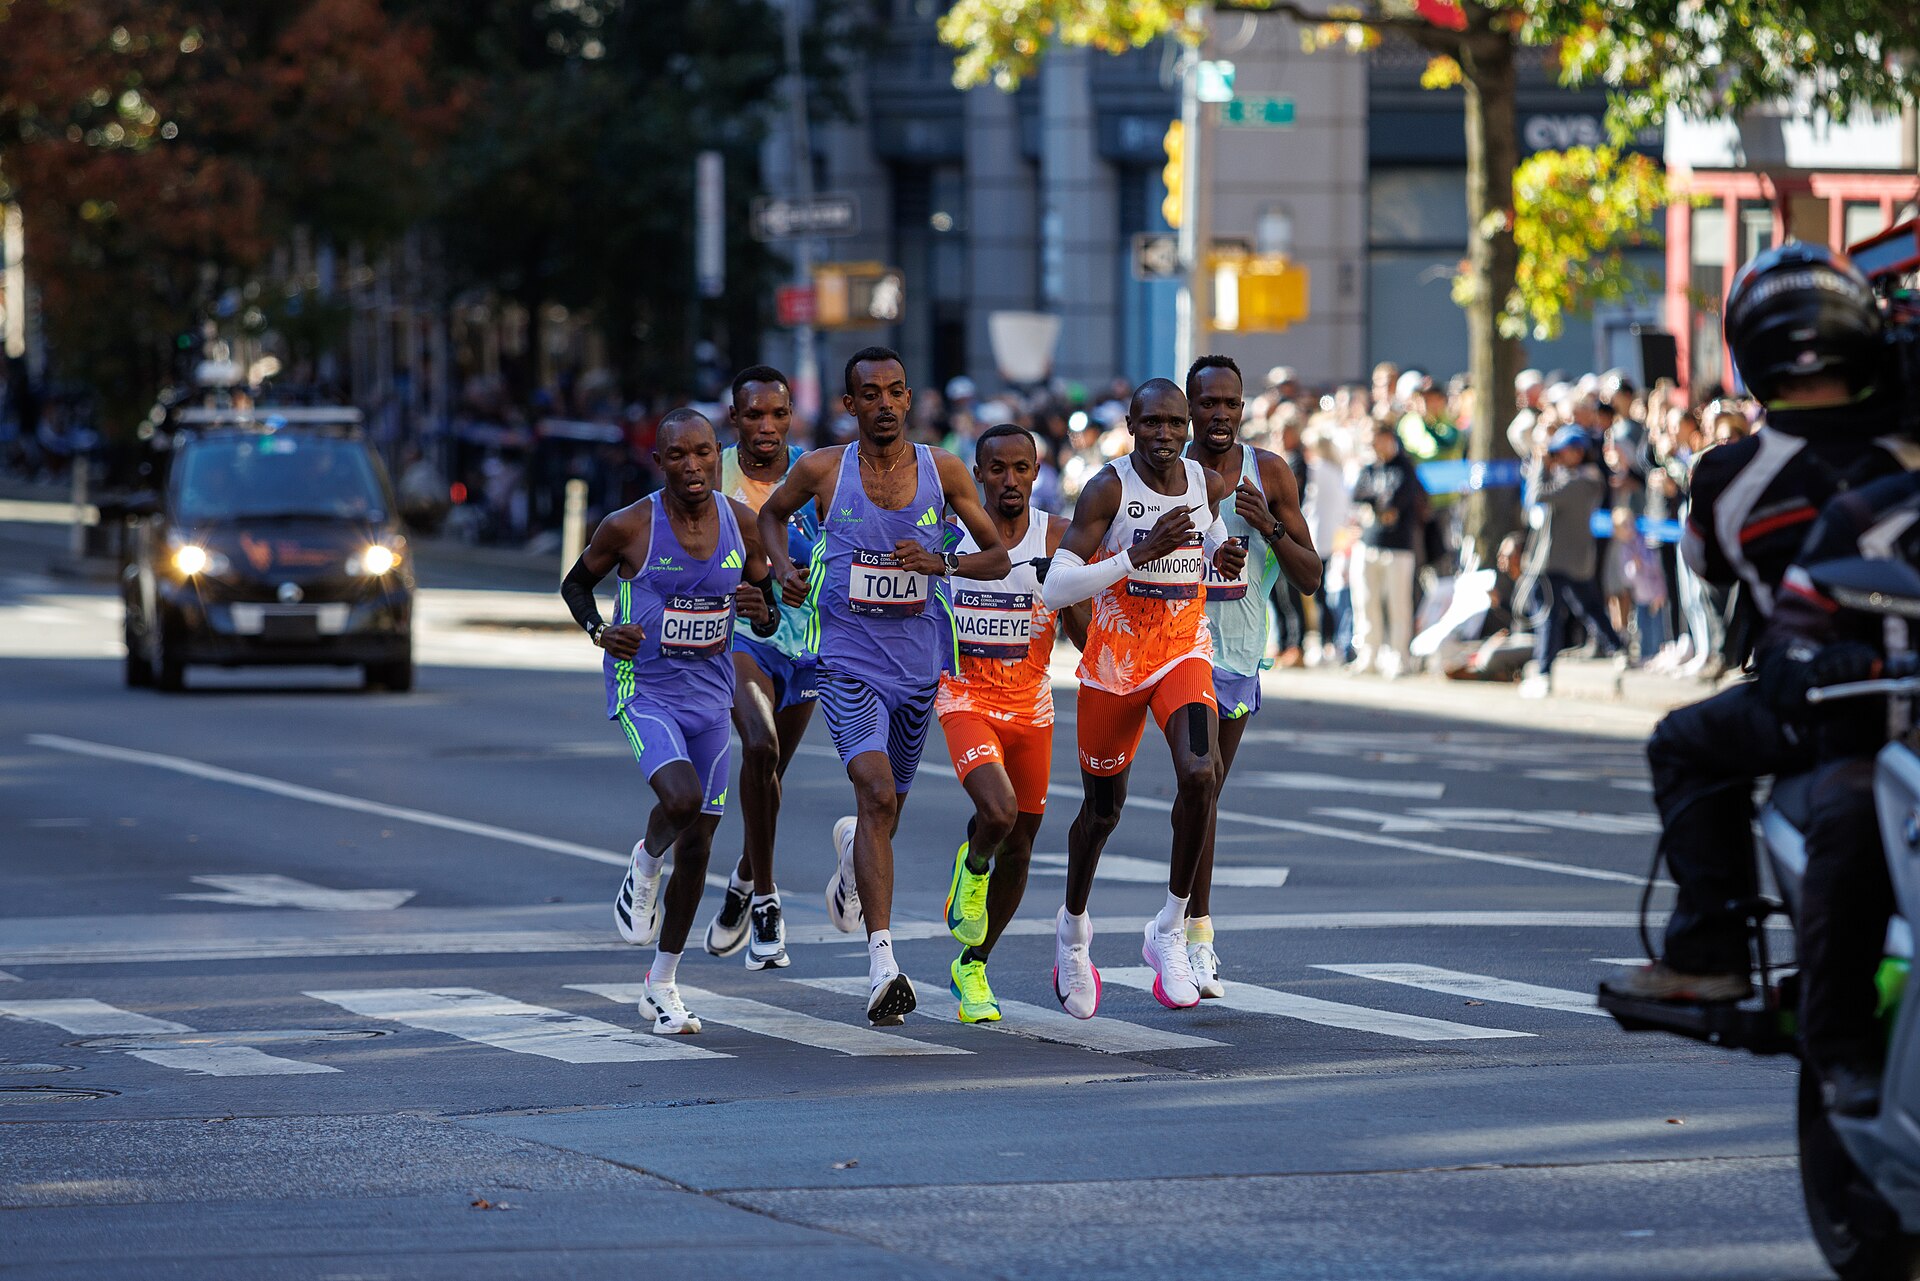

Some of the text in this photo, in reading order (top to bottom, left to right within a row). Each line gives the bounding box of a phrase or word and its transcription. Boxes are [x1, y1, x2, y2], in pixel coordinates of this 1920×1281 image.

[861, 551, 879, 565] tcs
[1136, 557, 1201, 574] AMWOROR
[864, 574, 918, 599] TOLA
[672, 596, 693, 610] tcs
[961, 592, 980, 606] tcs
[955, 615, 1030, 637] NAGEEYE
[800, 689, 819, 698] HOK
[956, 744, 1000, 773] INEOS
[1079, 747, 1125, 770] INEOS
